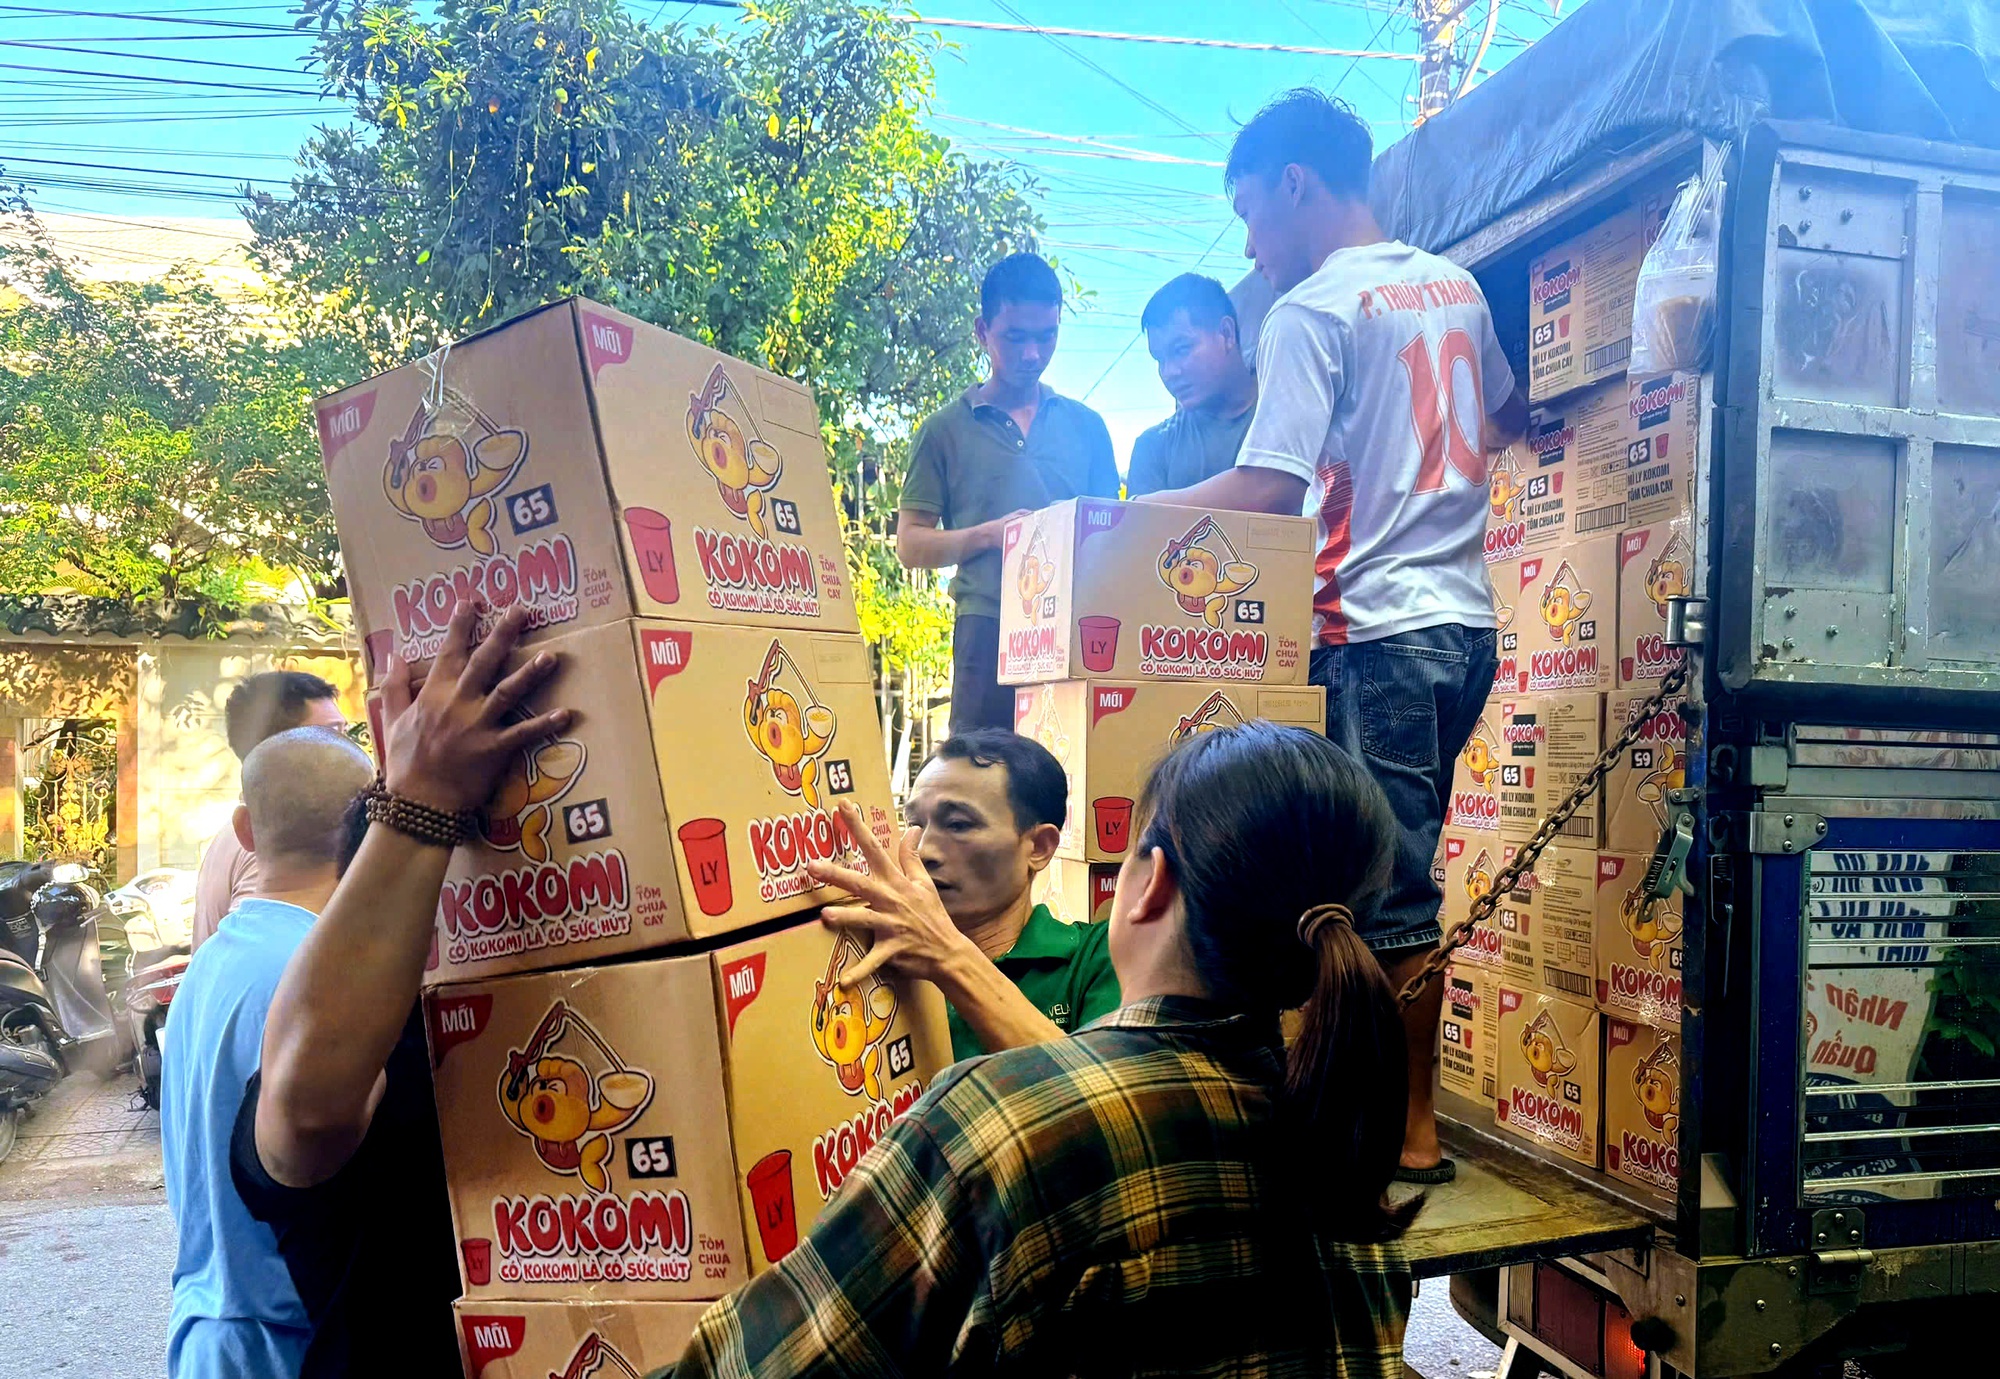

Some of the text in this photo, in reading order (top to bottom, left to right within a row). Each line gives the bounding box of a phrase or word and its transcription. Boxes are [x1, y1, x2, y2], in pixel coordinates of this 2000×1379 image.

[1533, 264, 1581, 305] KOKOMI
[1358, 291, 1382, 319] P.
[592, 325, 623, 356] MỚI
[1535, 325, 1551, 344] 65
[1629, 381, 1685, 419] KOKOMI
[1397, 329, 1488, 495] 10
[329, 405, 360, 438] MỚI
[1529, 426, 1574, 456] KOKOMI
[1630, 441, 1648, 462] 65
[1636, 471, 1643, 483] LY
[1643, 463, 1670, 481] KOKOMI
[1530, 479, 1546, 495] 65
[1641, 485, 1659, 498] CHUA
[1661, 479, 1673, 492] CAY
[513, 496, 550, 527] 65
[775, 501, 798, 530] 65
[1535, 501, 1542, 513] LY
[1088, 509, 1112, 526] MỚI
[1554, 512, 1565, 524] CAY
[646, 551, 664, 573] LY
[694, 528, 817, 597] KOKOMI
[820, 559, 836, 572] TÔM
[584, 569, 607, 583] TÔM
[821, 574, 841, 586] CHUA
[1524, 566, 1536, 578] MỚI
[392, 536, 577, 640] KOKOMI
[584, 581, 613, 597] CHUA
[828, 588, 841, 600] CAY
[591, 594, 611, 608] CAY
[708, 588, 720, 604] CÓ
[724, 592, 759, 609] KOKOMI
[761, 594, 772, 609] LÀ
[1044, 600, 1055, 616] 65
[1237, 603, 1260, 620] 65
[1580, 624, 1593, 637] 65
[650, 636, 681, 666] MỚI
[1008, 626, 1056, 659] KOKOMI
[1091, 639, 1106, 654] LY
[1140, 626, 1267, 665] KOKOMI
[1279, 638, 1297, 648] TÔM
[1504, 637, 1516, 650] 65
[1276, 650, 1298, 658] CHUA
[1531, 647, 1597, 677] KOKOMI
[1141, 661, 1153, 673] CÓ
[1157, 665, 1192, 675] KOKOMI
[1196, 664, 1206, 675] LÀ
[1210, 665, 1221, 676] CÓ
[1245, 666, 1261, 679] HÚT
[1279, 660, 1295, 668] CAY
[1100, 691, 1122, 708] MỚI
[1502, 725, 1545, 744] KOKOMI
[1634, 751, 1651, 767] 65
[828, 763, 850, 790] 65
[1504, 767, 1519, 784] 65
[1509, 793, 1514, 802] LY
[568, 805, 605, 838] 65
[871, 808, 886, 821] TÔM
[1513, 807, 1526, 817] CHUA
[1527, 808, 1536, 818] CAY
[872, 825, 891, 836] CHUA
[1106, 822, 1121, 836] LY
[701, 860, 719, 886] LY
[1435, 869, 1445, 880] 65
[1601, 860, 1616, 876] MỚI
[441, 850, 626, 941] KOKOMI
[637, 886, 661, 899] TÔM
[761, 880, 773, 899] CÓ
[637, 901, 667, 915] CHUA
[644, 914, 664, 927] CAY
[1503, 910, 1516, 928] 65
[450, 940, 466, 959] CÓ
[470, 934, 521, 957] KOKOMI
[526, 927, 543, 947] LÀ
[550, 924, 565, 942] CÓ
[601, 914, 628, 935] HÚT
[729, 966, 755, 999] MỚI
[1443, 987, 1481, 1011] KOKOMI
[441, 1005, 475, 1033] MỚI
[1445, 1024, 1459, 1041] 65
[1613, 1025, 1628, 1041] MỚI
[890, 1039, 911, 1073] 65
[1565, 1083, 1579, 1100] 65
[1511, 1085, 1583, 1140] KOKOMI
[630, 1140, 668, 1174] 65
[767, 1197, 784, 1229] LY
[493, 1191, 692, 1256] KOKOMI
[701, 1239, 724, 1250] TÔM
[501, 1256, 689, 1279] CÓ KOKOMI LÀ CÓ SỨC HÚT
[699, 1253, 730, 1264] CHUA
[704, 1267, 727, 1278] CAY
[474, 1322, 512, 1349] MỚI
